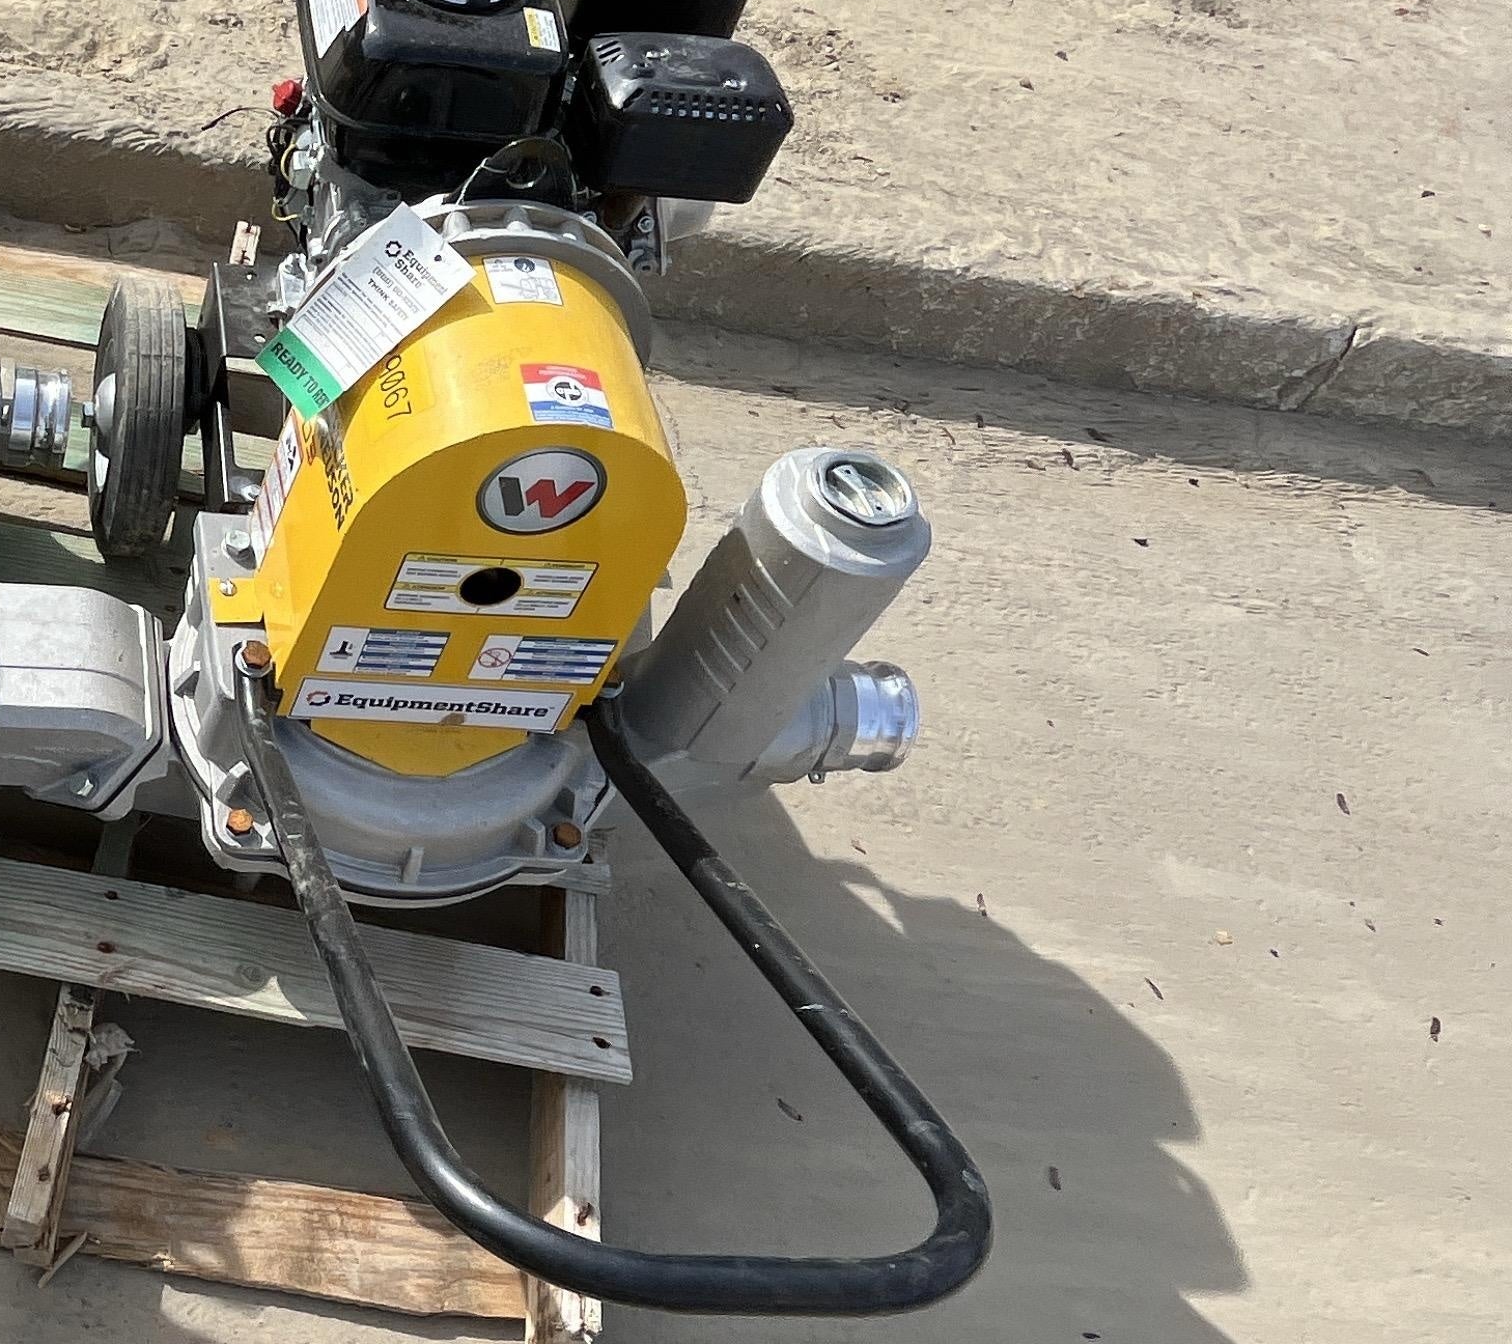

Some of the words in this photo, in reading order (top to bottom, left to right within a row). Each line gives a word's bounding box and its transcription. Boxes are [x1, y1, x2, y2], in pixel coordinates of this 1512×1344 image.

[394, 259, 424, 290] Share
[402, 249, 449, 296] Equipment
[271, 341, 307, 382] READY
[303, 374, 319, 394] TO
[334, 692, 551, 719] EquipmentShare
